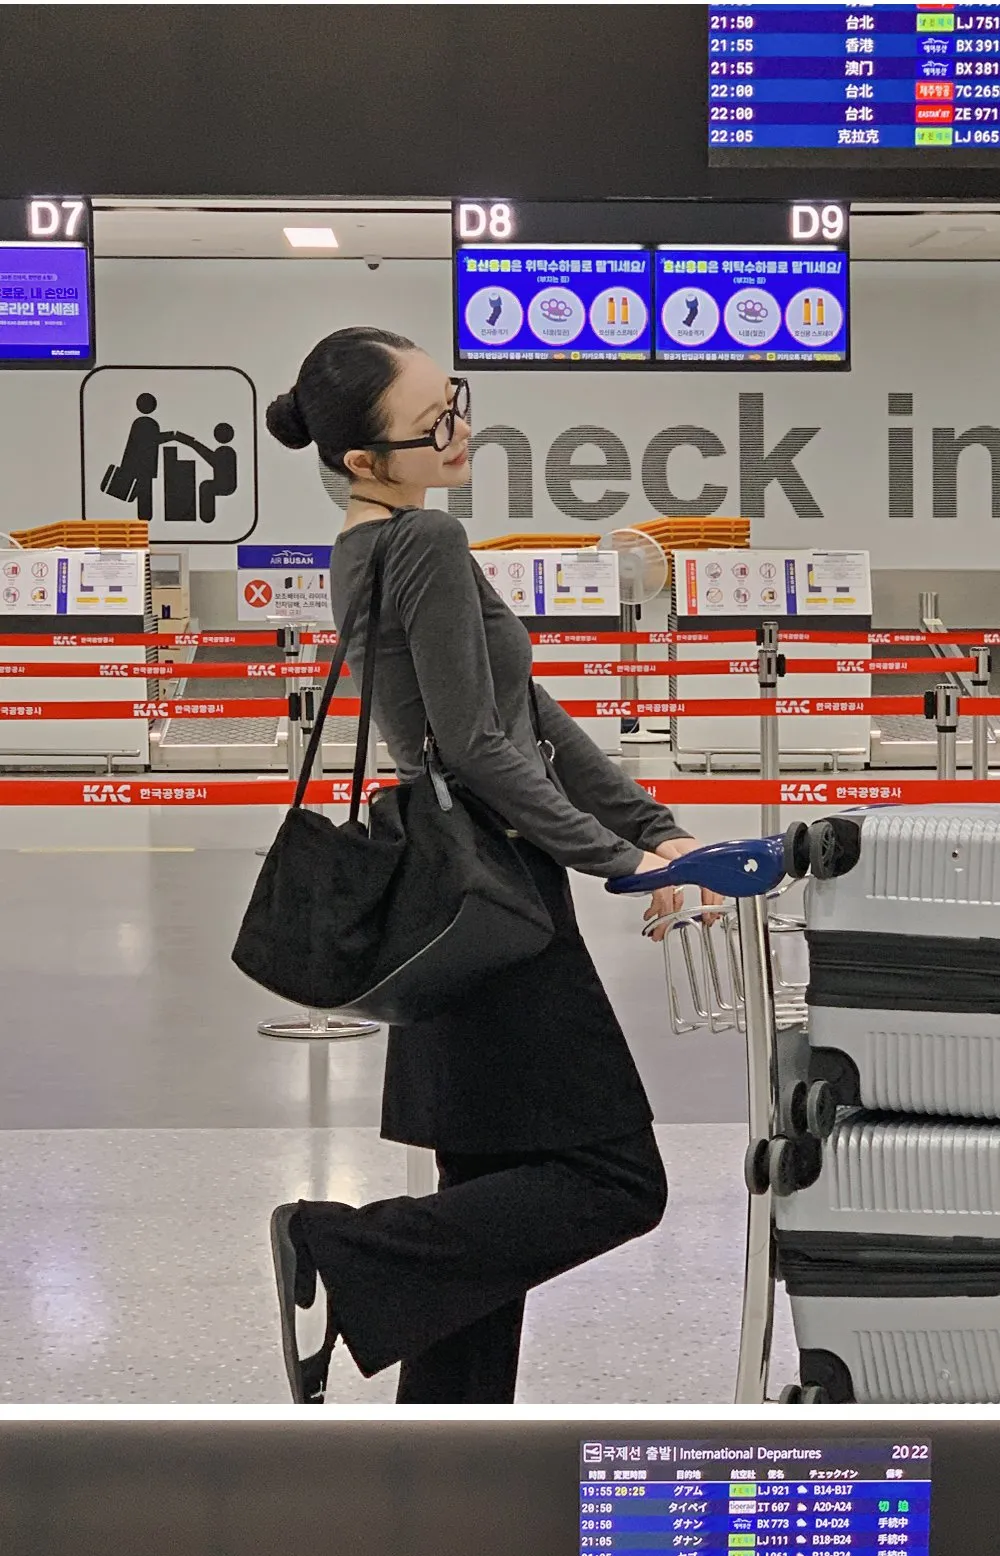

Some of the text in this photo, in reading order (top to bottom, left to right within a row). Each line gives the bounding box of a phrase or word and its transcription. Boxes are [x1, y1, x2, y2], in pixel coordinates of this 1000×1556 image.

[711, 15, 999, 30] 21:50 台北 LJ 751
[711, 38, 999, 52] 21:55 香港 BX 391
[711, 61, 998, 76] 21:55 澳门 BX 381
[711, 85, 753, 97] 22:00
[845, 84, 873, 99] 台北
[920, 84, 949, 97] 제주항공
[956, 85, 972, 97] 7C
[711, 106, 997, 121] 22:00 台北 ZE 971
[711, 129, 999, 143] 22:05 克拉克 LJ 065
[30, 201, 83, 235] D7
[460, 204, 511, 238] D8
[792, 205, 844, 239] D9
[466, 259, 521, 272] 호신용품은
[526, 259, 592, 272] 위탁수하물로
[663, 260, 719, 273] 호신용품은
[722, 260, 788, 273] 위탁수하물로
[31, 288, 78, 299] 내 손안의
[37, 302, 79, 316] 면세점!
[888, 393, 1000, 518] in
[53, 636, 77, 645] KAC
[175, 635, 198, 644] KAC
[868, 634, 890, 643] KAC
[100, 665, 128, 676] KAC
[247, 665, 276, 676] KAC
[134, 703, 168, 717] KAC
[175, 704, 224, 714] 한국공항공사
[776, 700, 864, 714] KAC 한국공항공사
[84, 785, 207, 803] KAC 한국공항공사
[781, 784, 901, 802] KAC 한국공항공사
[603, 1447, 640, 1461] 국제선
[681, 1447, 752, 1459] International
[758, 1448, 821, 1462] Departures
[677, 1470, 701, 1480] 目的地
[583, 1487, 612, 1496] 19:55
[615, 1487, 645, 1496] 20:25
[674, 1486, 703, 1496] グアム
[756, 1486, 770, 1495] LJ
[772, 1486, 789, 1495] 921
[814, 1485, 853, 1495] B14-B17
[582, 1503, 612, 1513] 20:50
[669, 1502, 707, 1513] タイペイ
[758, 1503, 770, 1512] IT
[772, 1502, 790, 1512] 607
[813, 1502, 852, 1511] A20-A24
[582, 1517, 908, 1529] 20:50 ダナン BX 773 D4-D24 手続中
[582, 1534, 908, 1546] 21:05 ダナン LJ 111 B18-B24 手続中
